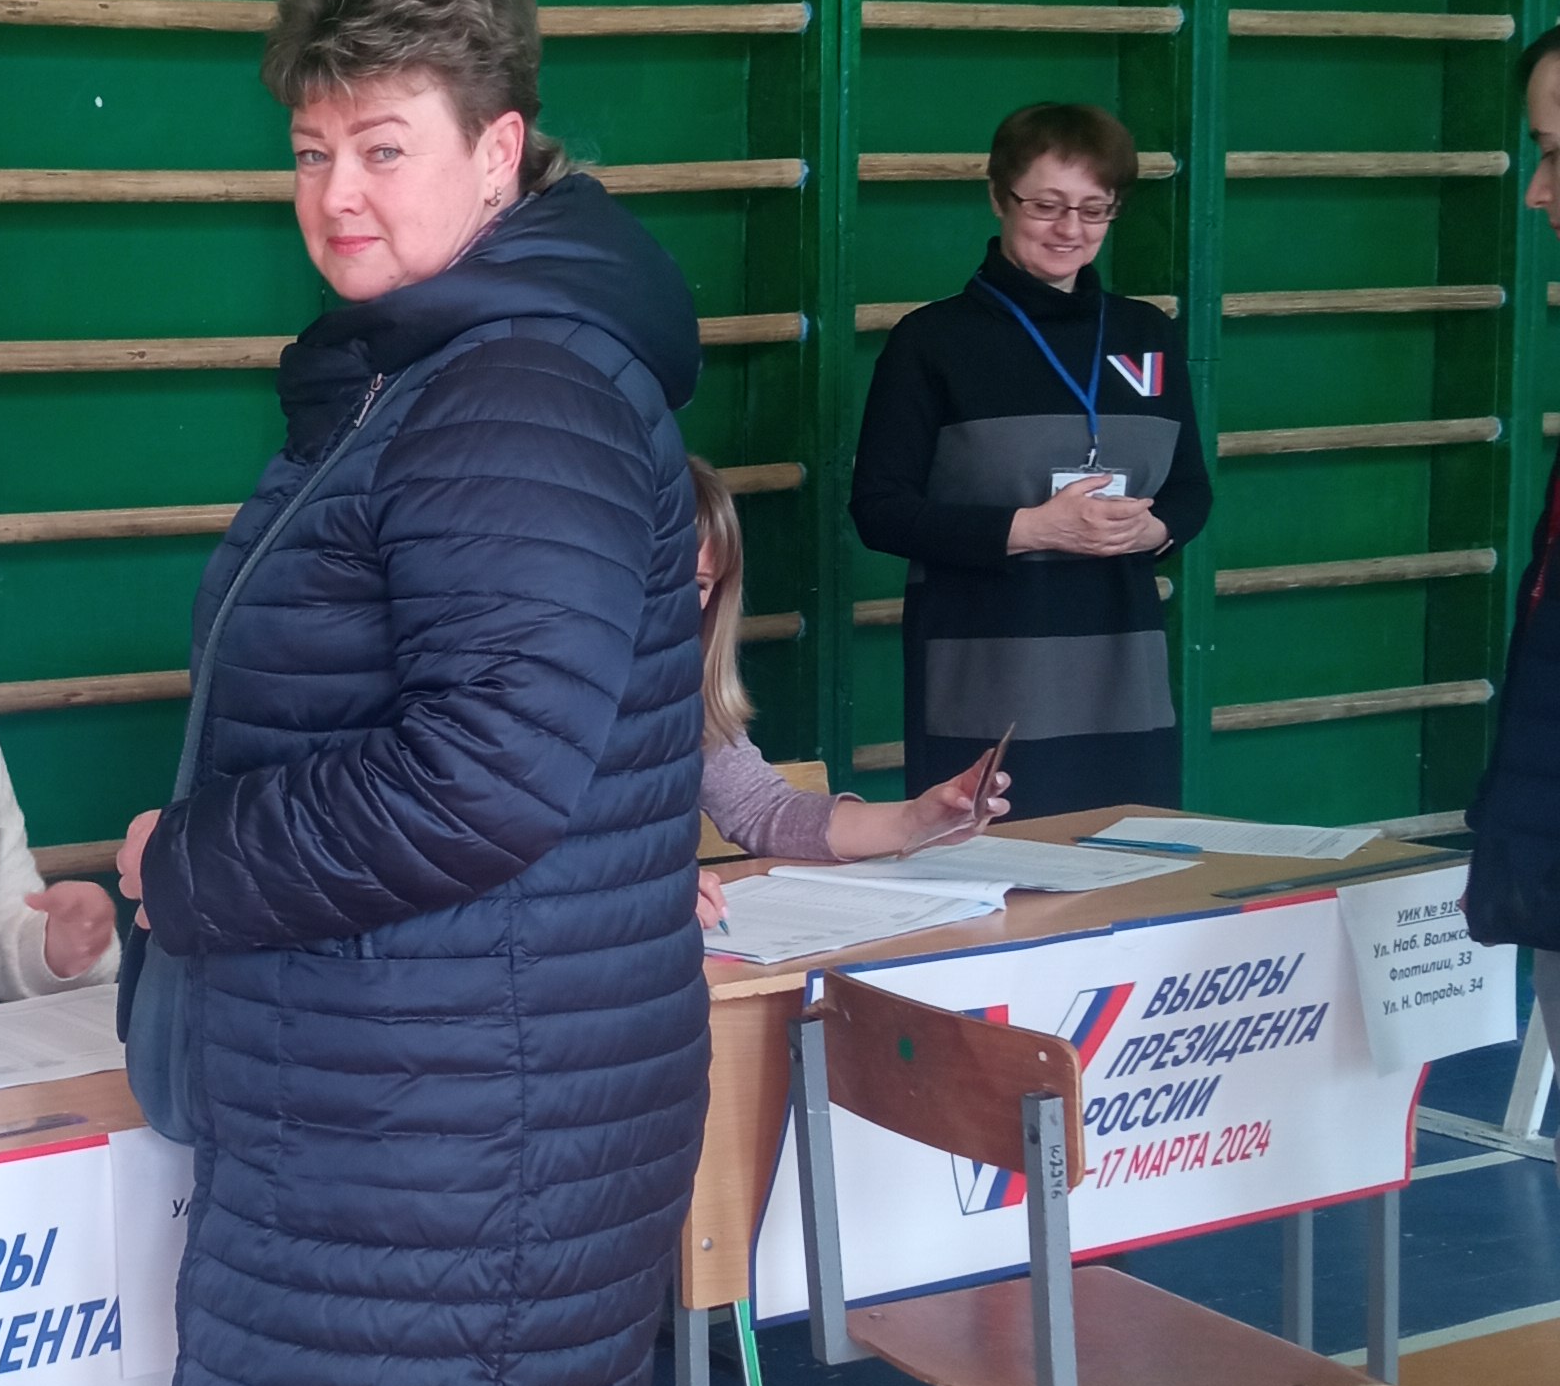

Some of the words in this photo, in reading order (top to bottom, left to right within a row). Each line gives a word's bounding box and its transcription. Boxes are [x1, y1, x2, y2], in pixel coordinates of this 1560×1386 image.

[1397, 906, 1421, 924] УИК
[1424, 904, 1438, 918] №
[1373, 944, 1389, 958] Ул.
[1393, 934, 1420, 953] Наб.
[1423, 928, 1470, 948] Волжс
[1390, 958, 1453, 981] Флотилии,
[1458, 951, 1473, 967] 33
[1141, 953, 1305, 1019] ВЫБОРЫ
[1383, 1000, 1398, 1015] Ул.
[1401, 995, 1412, 1009] Н.
[1414, 983, 1466, 1004] Отрады,
[1469, 977, 1483, 993] 34
[1104, 1002, 1329, 1079] ПРЕЗИДЕНТА
[1083, 1074, 1222, 1136] РОССИИ
[1067, 1146, 1127, 1194] -17
[1124, 1131, 1210, 1183] МАРТА
[1211, 1120, 1271, 1166] 2024
